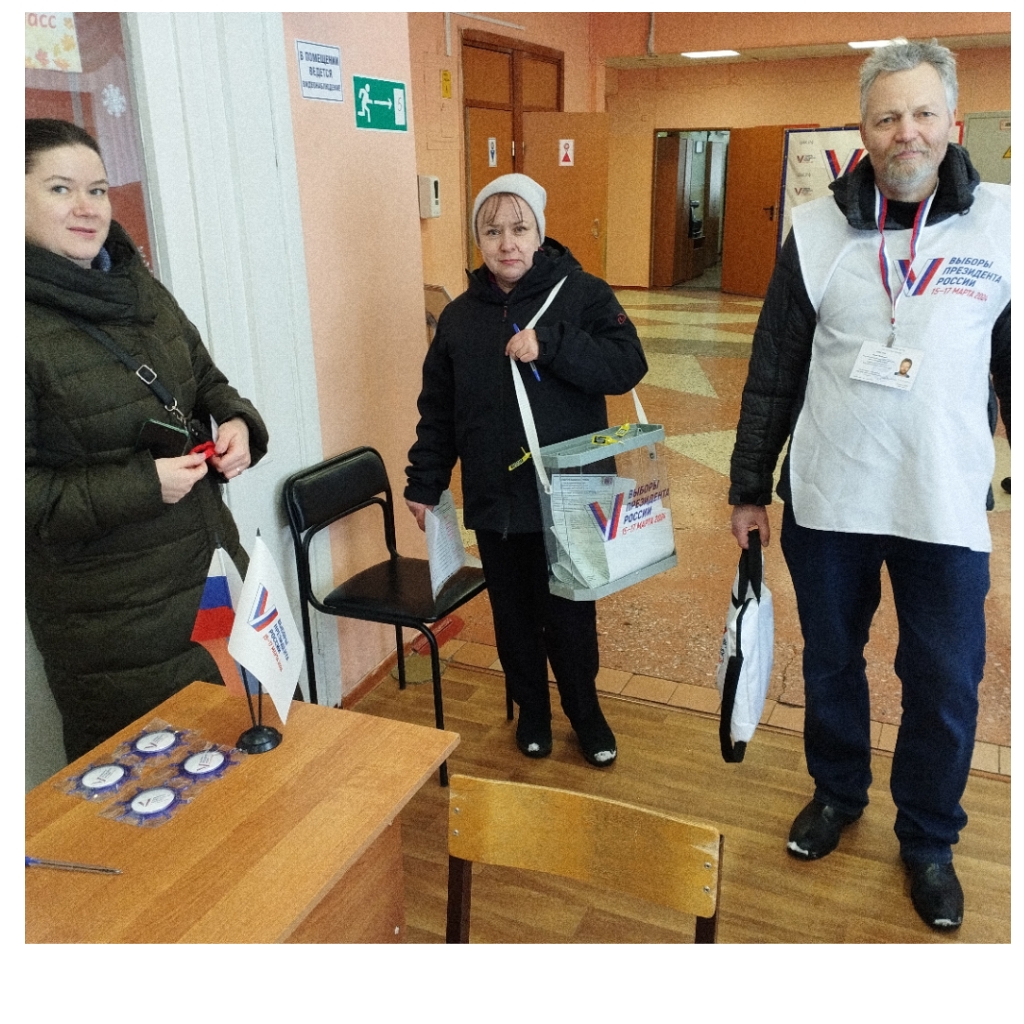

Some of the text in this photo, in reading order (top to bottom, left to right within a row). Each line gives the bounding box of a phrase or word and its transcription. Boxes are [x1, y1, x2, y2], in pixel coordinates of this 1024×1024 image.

[305, 52, 338, 65] ПОМЕЩЕНИИ
[309, 67, 332, 78] ВЕДЕТСЯ
[949, 257, 994, 268] ВЫБОРЫ
[942, 267, 1002, 283] ПРЕЗИДЕНТА
[936, 277, 977, 287] РОССИИ
[952, 288, 975, 296] МАРТА
[628, 480, 660, 499] ВЫБОРЫ
[626, 488, 669, 512] ПРЕЗИДЕНТА
[624, 506, 652, 524] РОССИИ
